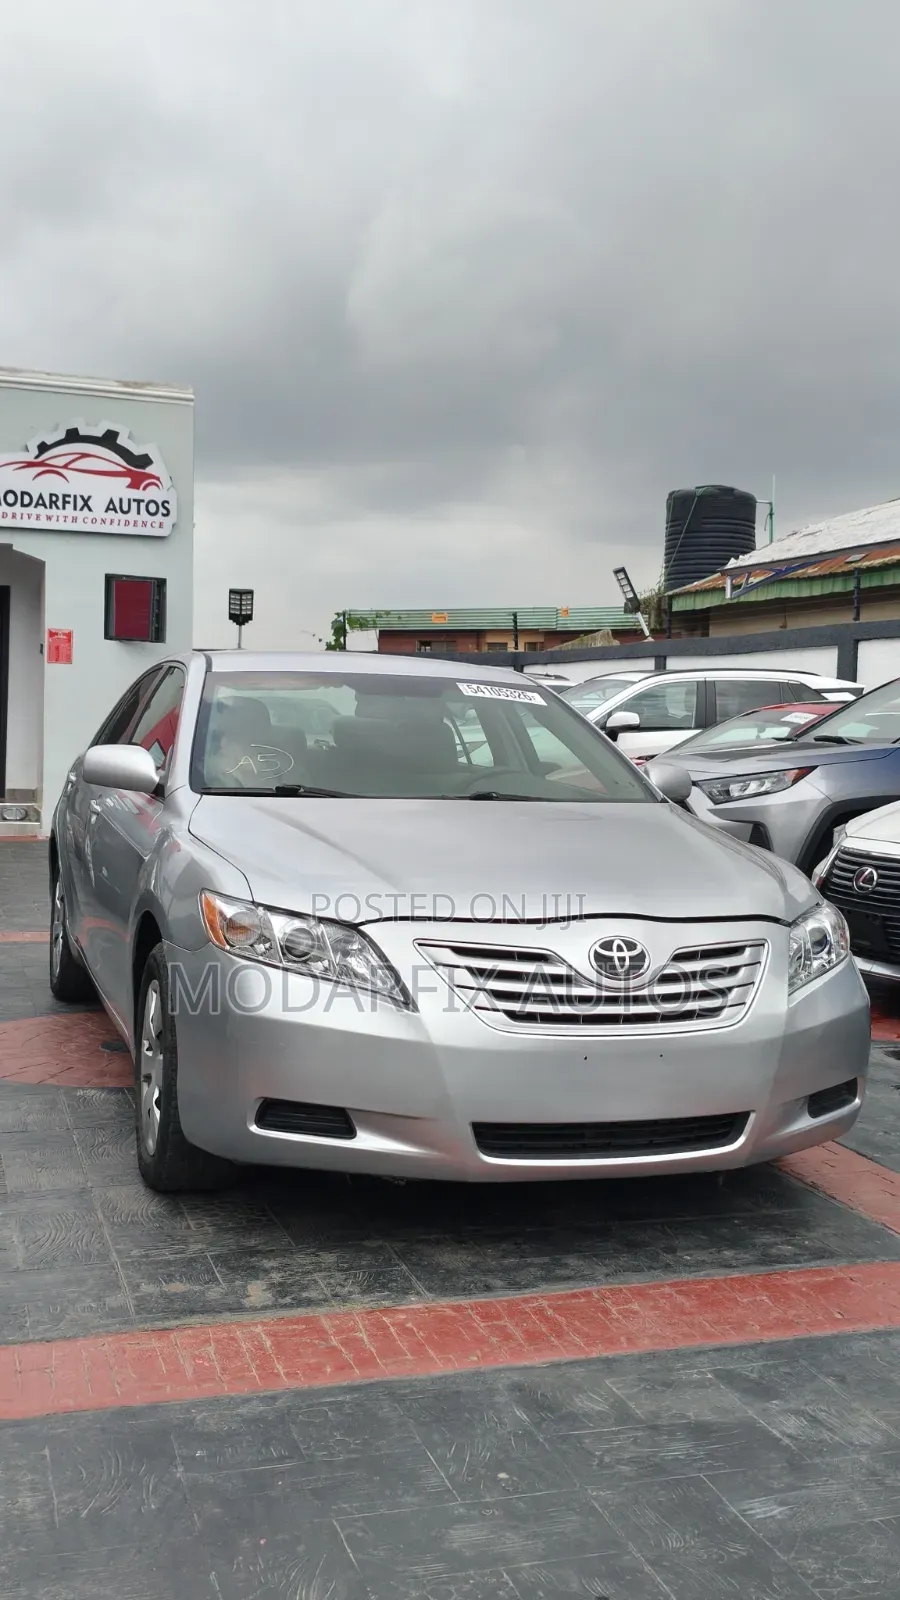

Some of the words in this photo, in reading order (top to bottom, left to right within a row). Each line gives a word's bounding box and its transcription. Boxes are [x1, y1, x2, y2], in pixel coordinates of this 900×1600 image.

[0, 489, 93, 512] ODARFIX
[104, 496, 171, 518] AUTOS
[1, 511, 41, 521] DRIVE
[45, 514, 78, 524] WITH
[82, 516, 165, 529] CONFIDENCE
